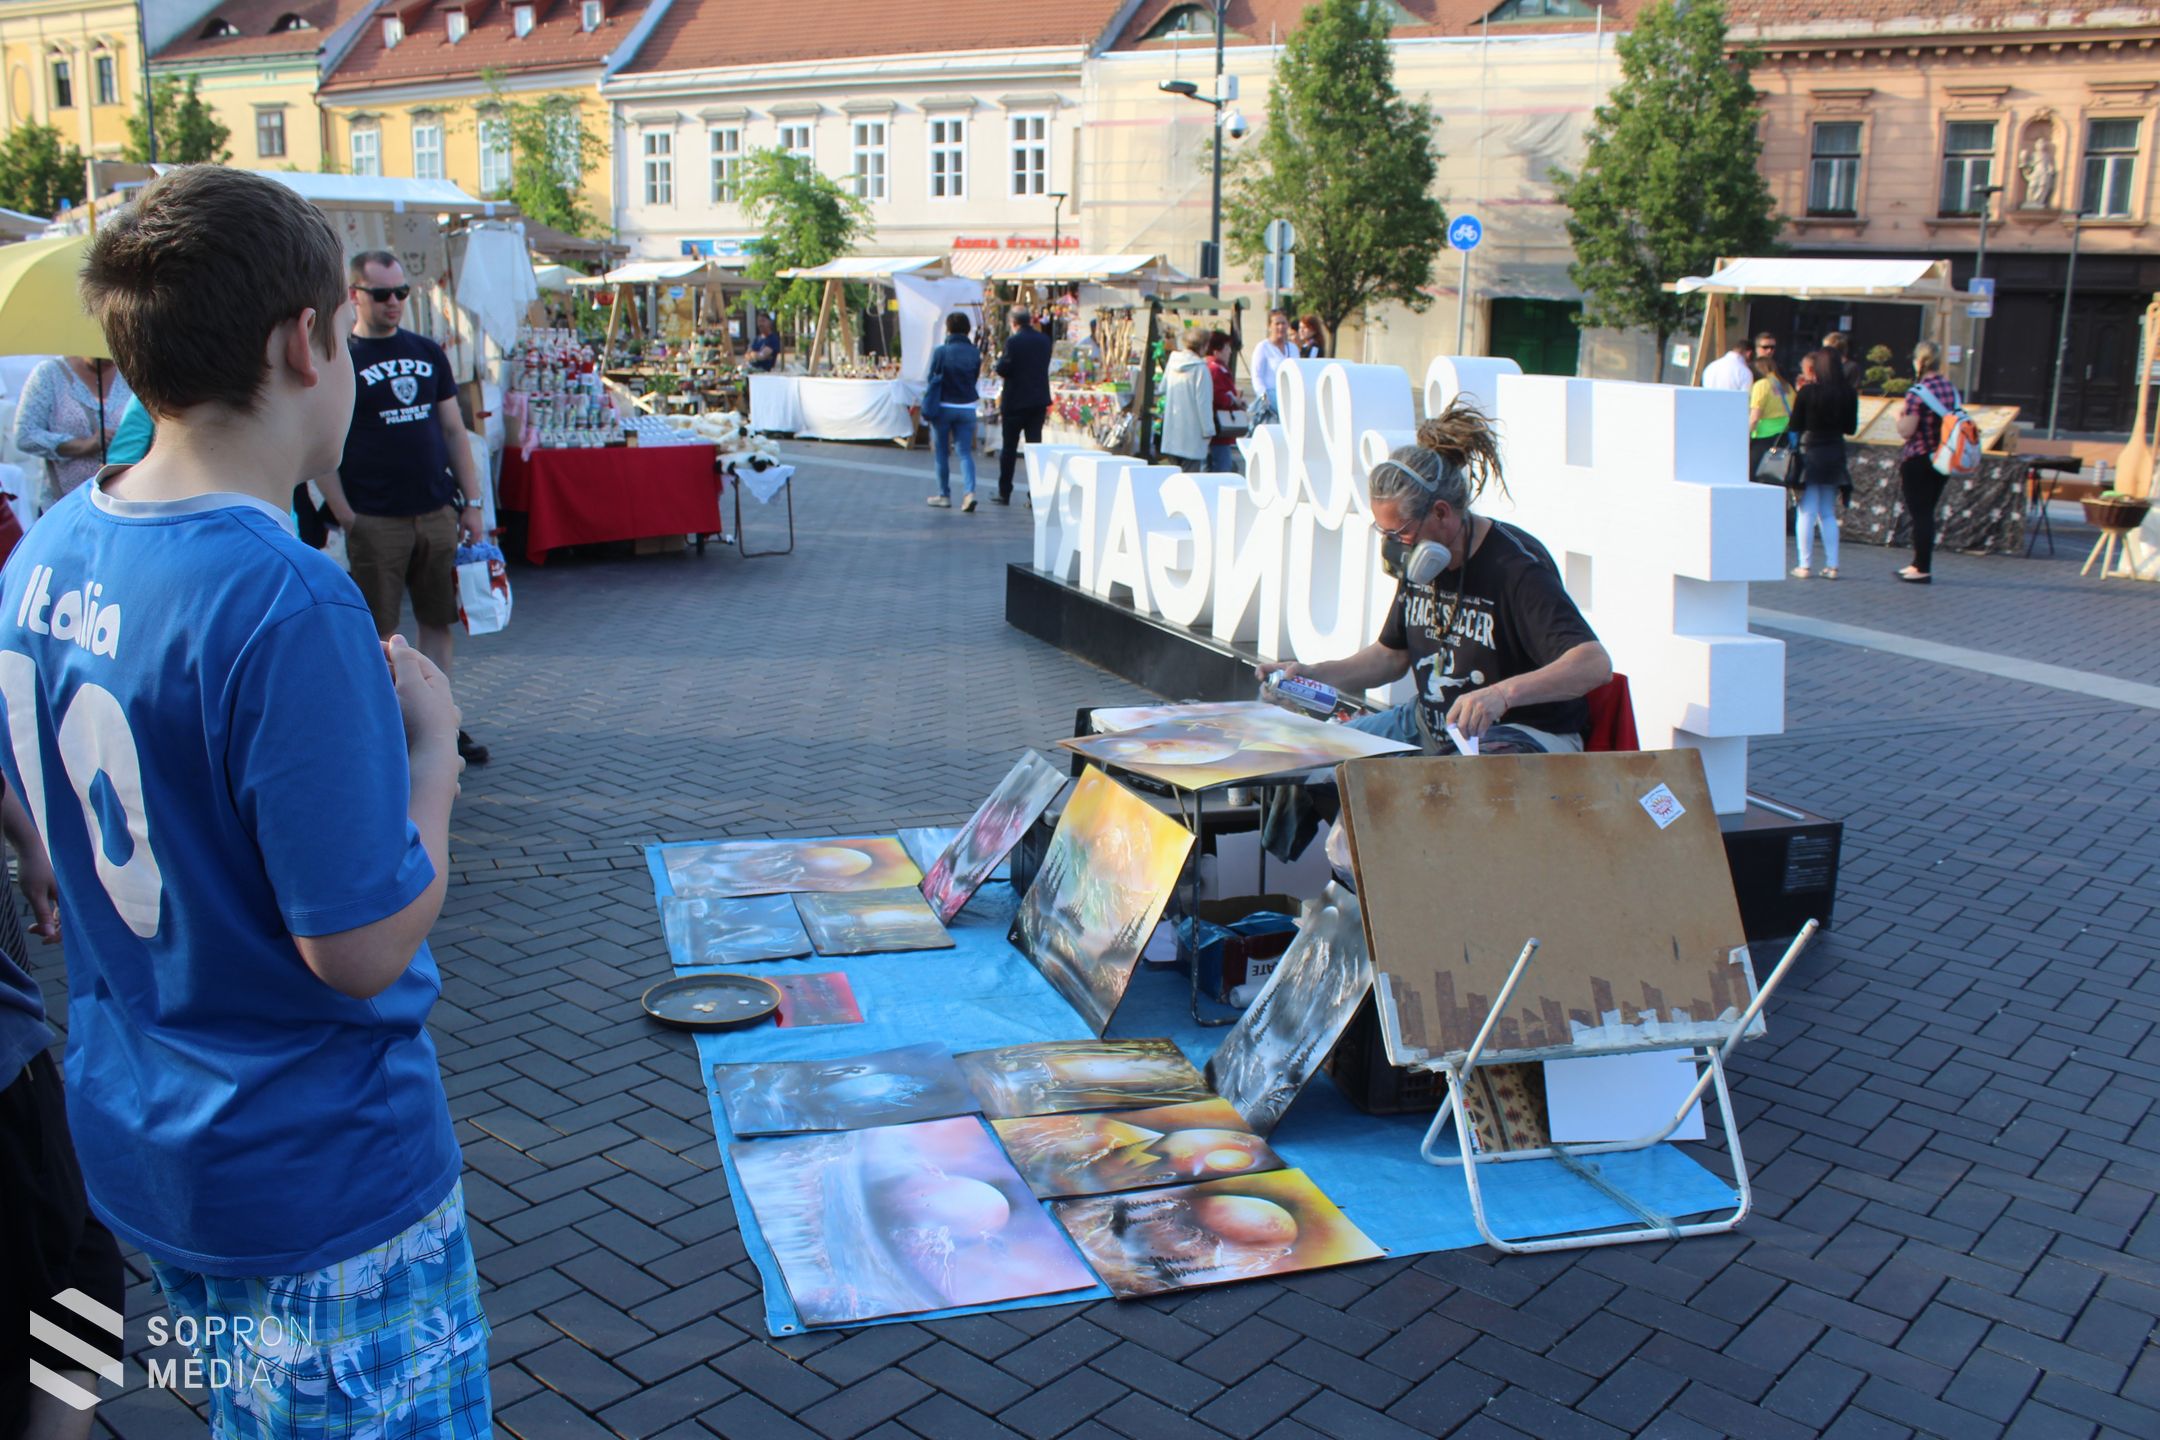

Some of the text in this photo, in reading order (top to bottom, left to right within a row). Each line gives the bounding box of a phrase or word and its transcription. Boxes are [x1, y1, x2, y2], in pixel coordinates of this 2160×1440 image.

[359, 358, 433, 386] NYPD
[17, 564, 121, 660] Italia
[1443, 603, 1497, 650] SCCER
[0, 649, 163, 938] 10
